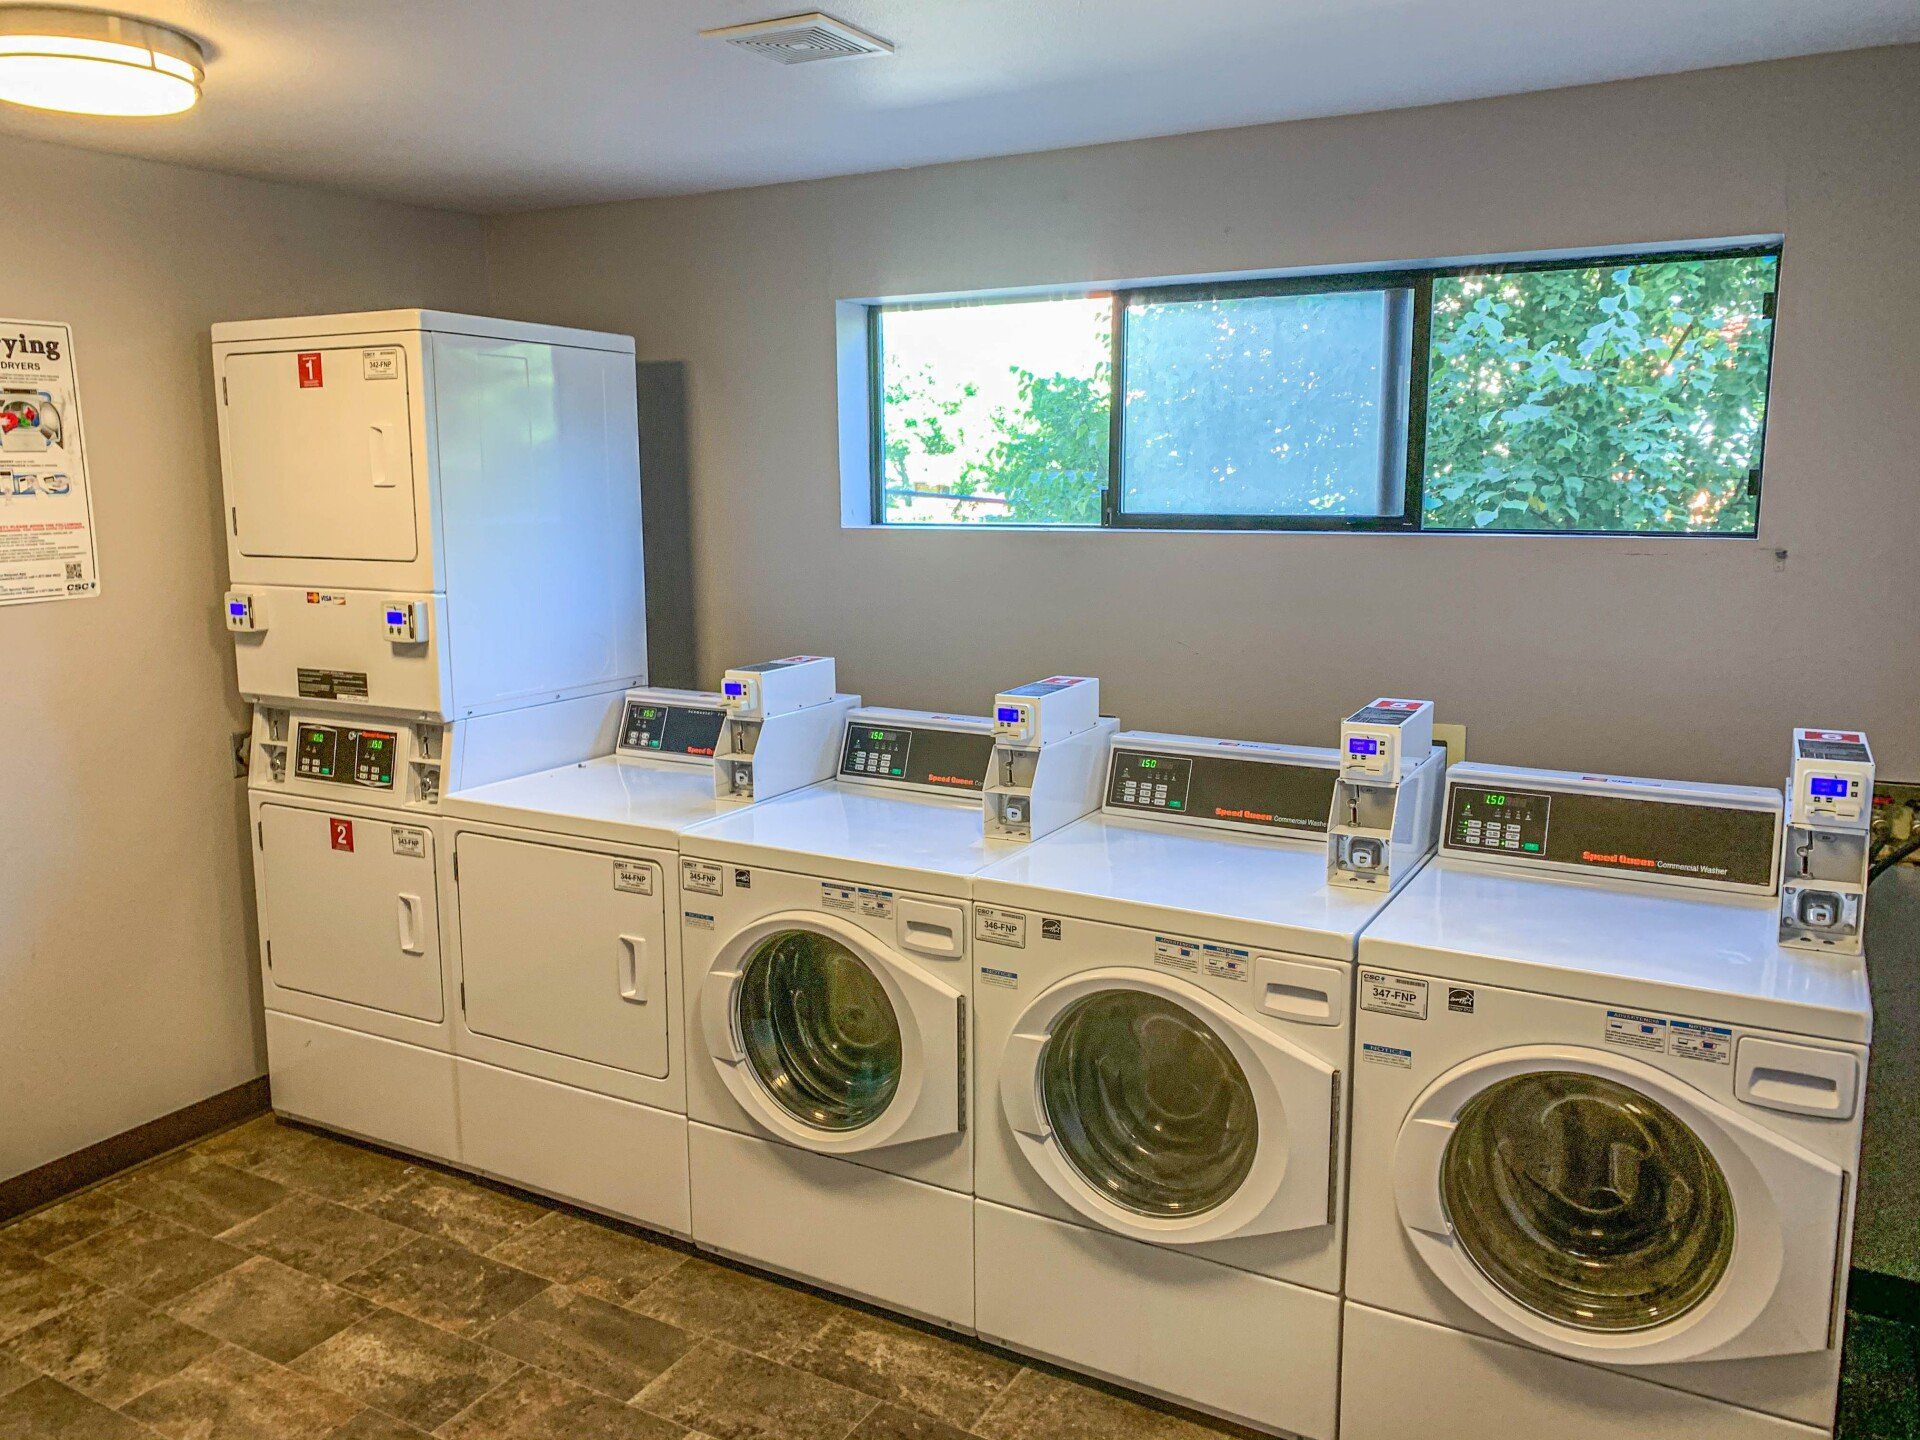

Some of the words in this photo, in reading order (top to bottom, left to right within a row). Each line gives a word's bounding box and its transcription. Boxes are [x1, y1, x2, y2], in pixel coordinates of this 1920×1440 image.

[0, 333, 61, 361] ying
[0, 361, 41, 371] DRYERS
[305, 359, 314, 380] 1
[66, 582, 89, 592] CSC
[928, 773, 951, 783] Speed
[951, 776, 974, 785] Queen
[1215, 807, 1243, 817] Speed
[1244, 810, 1273, 821] Queen
[1273, 815, 1307, 825] Commercial
[1307, 819, 1327, 828] Washe
[337, 825, 347, 845] 2
[1582, 851, 1618, 863] Speed
[1619, 854, 1656, 867] Queen
[1656, 860, 1700, 872] Commercial
[1700, 865, 1728, 876] Washer
[620, 872, 646, 883] 344-FNP
[690, 872, 716, 883] 345-FNP
[984, 920, 1018, 933] 346-FNP
[1363, 973, 1381, 981] CSC
[1372, 987, 1417, 1003] 347-FNP
